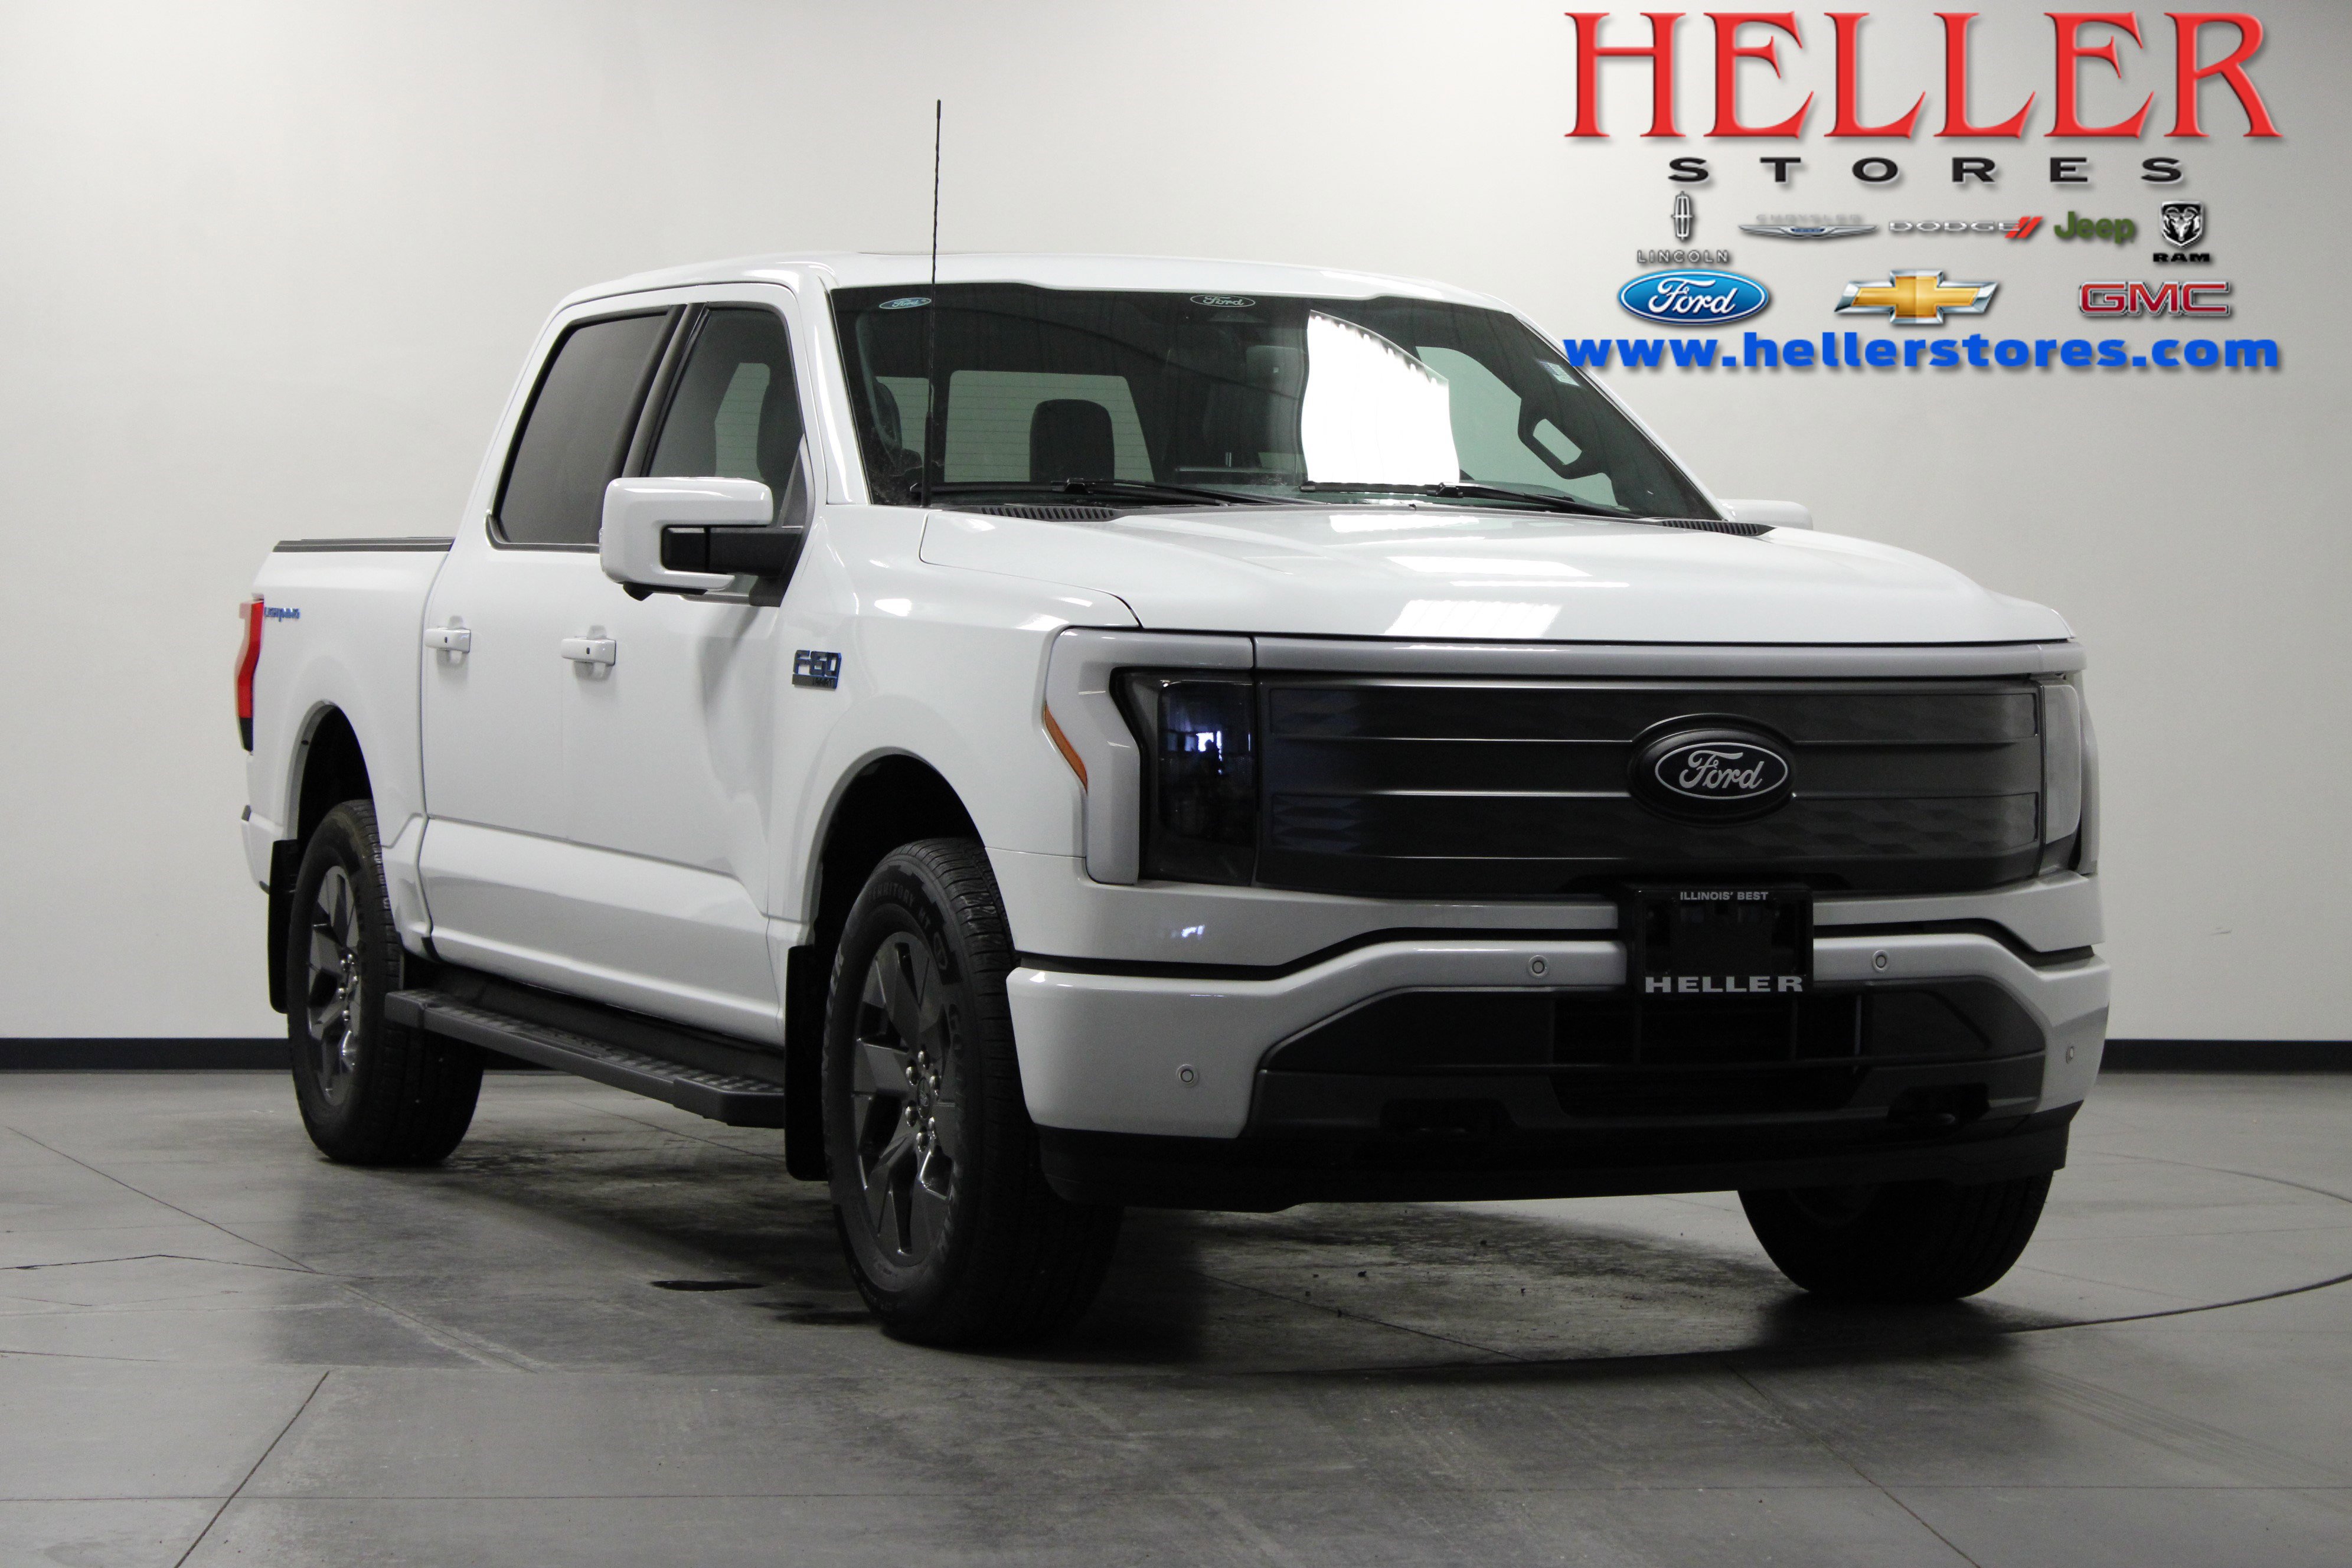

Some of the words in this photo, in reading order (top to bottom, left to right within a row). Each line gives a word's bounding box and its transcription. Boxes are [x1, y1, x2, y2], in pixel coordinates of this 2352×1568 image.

[1202, 296, 1244, 306] Ford
[1678, 749, 1765, 789] Ford
[1737, 891, 1769, 901] BEST
[1645, 975, 1803, 993] HELLER
